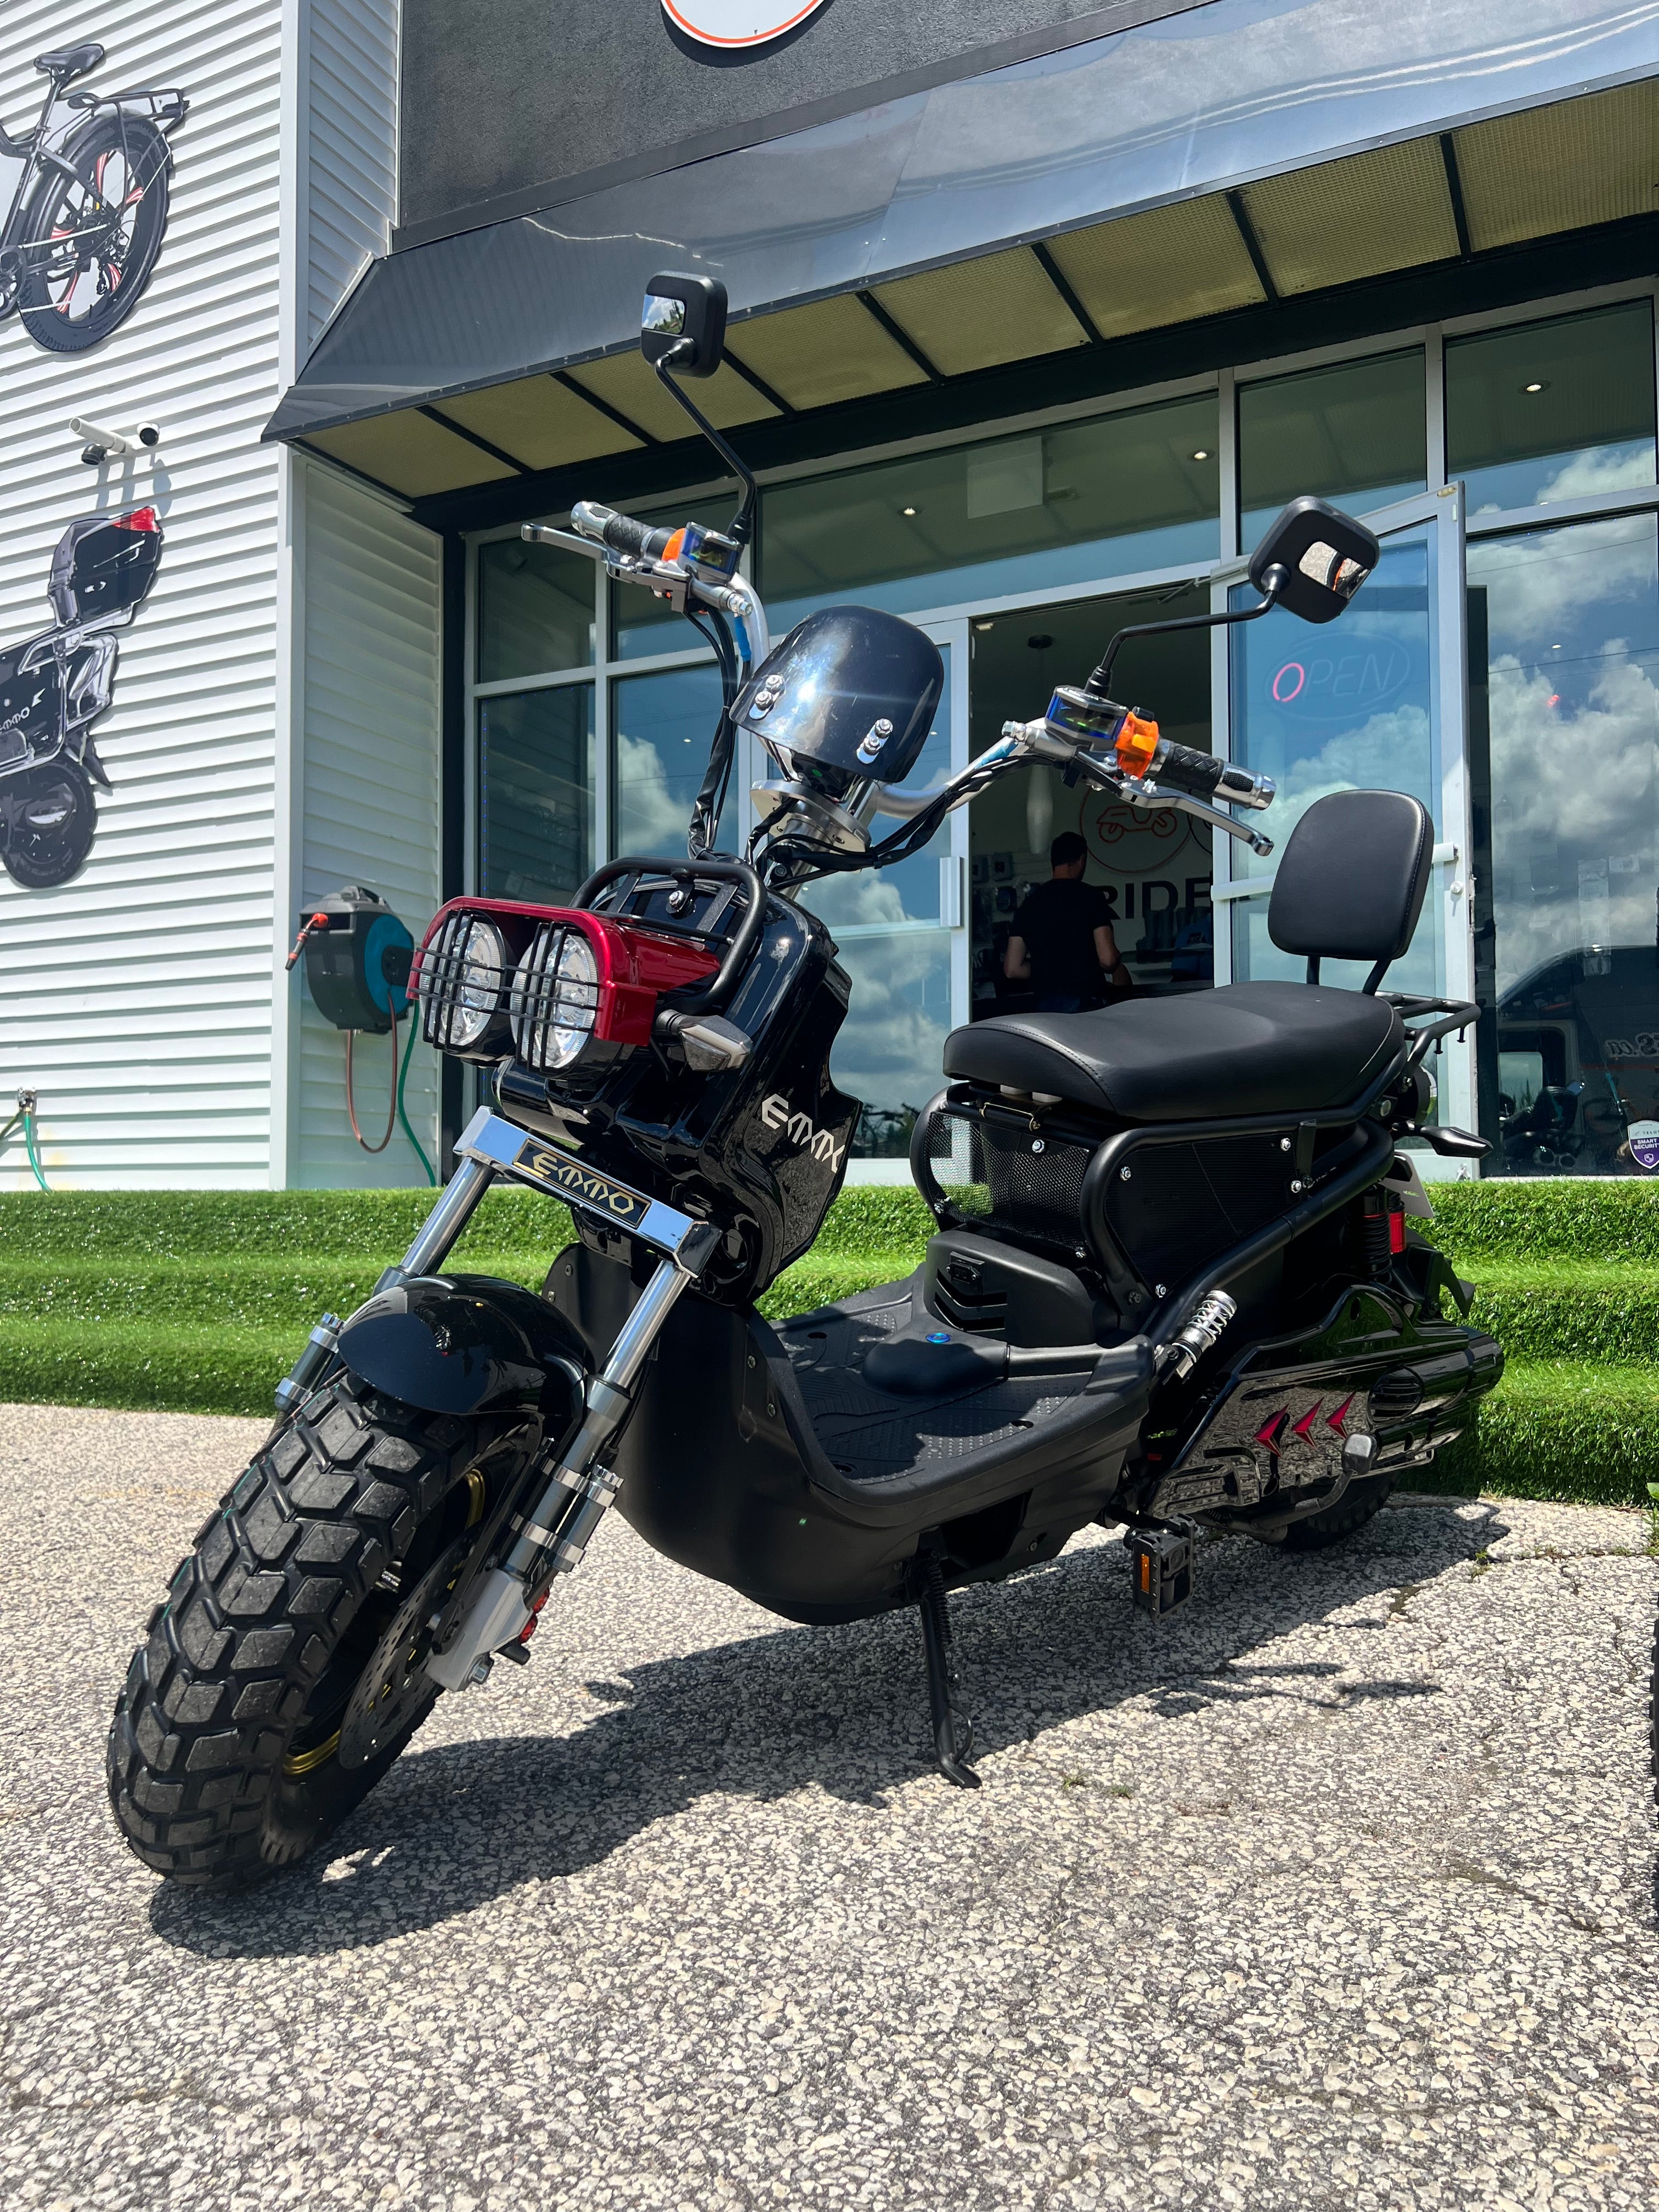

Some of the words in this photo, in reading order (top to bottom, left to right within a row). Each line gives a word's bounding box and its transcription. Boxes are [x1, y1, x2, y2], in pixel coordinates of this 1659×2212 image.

[1272, 651, 1395, 702] OPEN
[0, 707, 30, 731] MMO
[533, 1152, 634, 1215] EMMO
